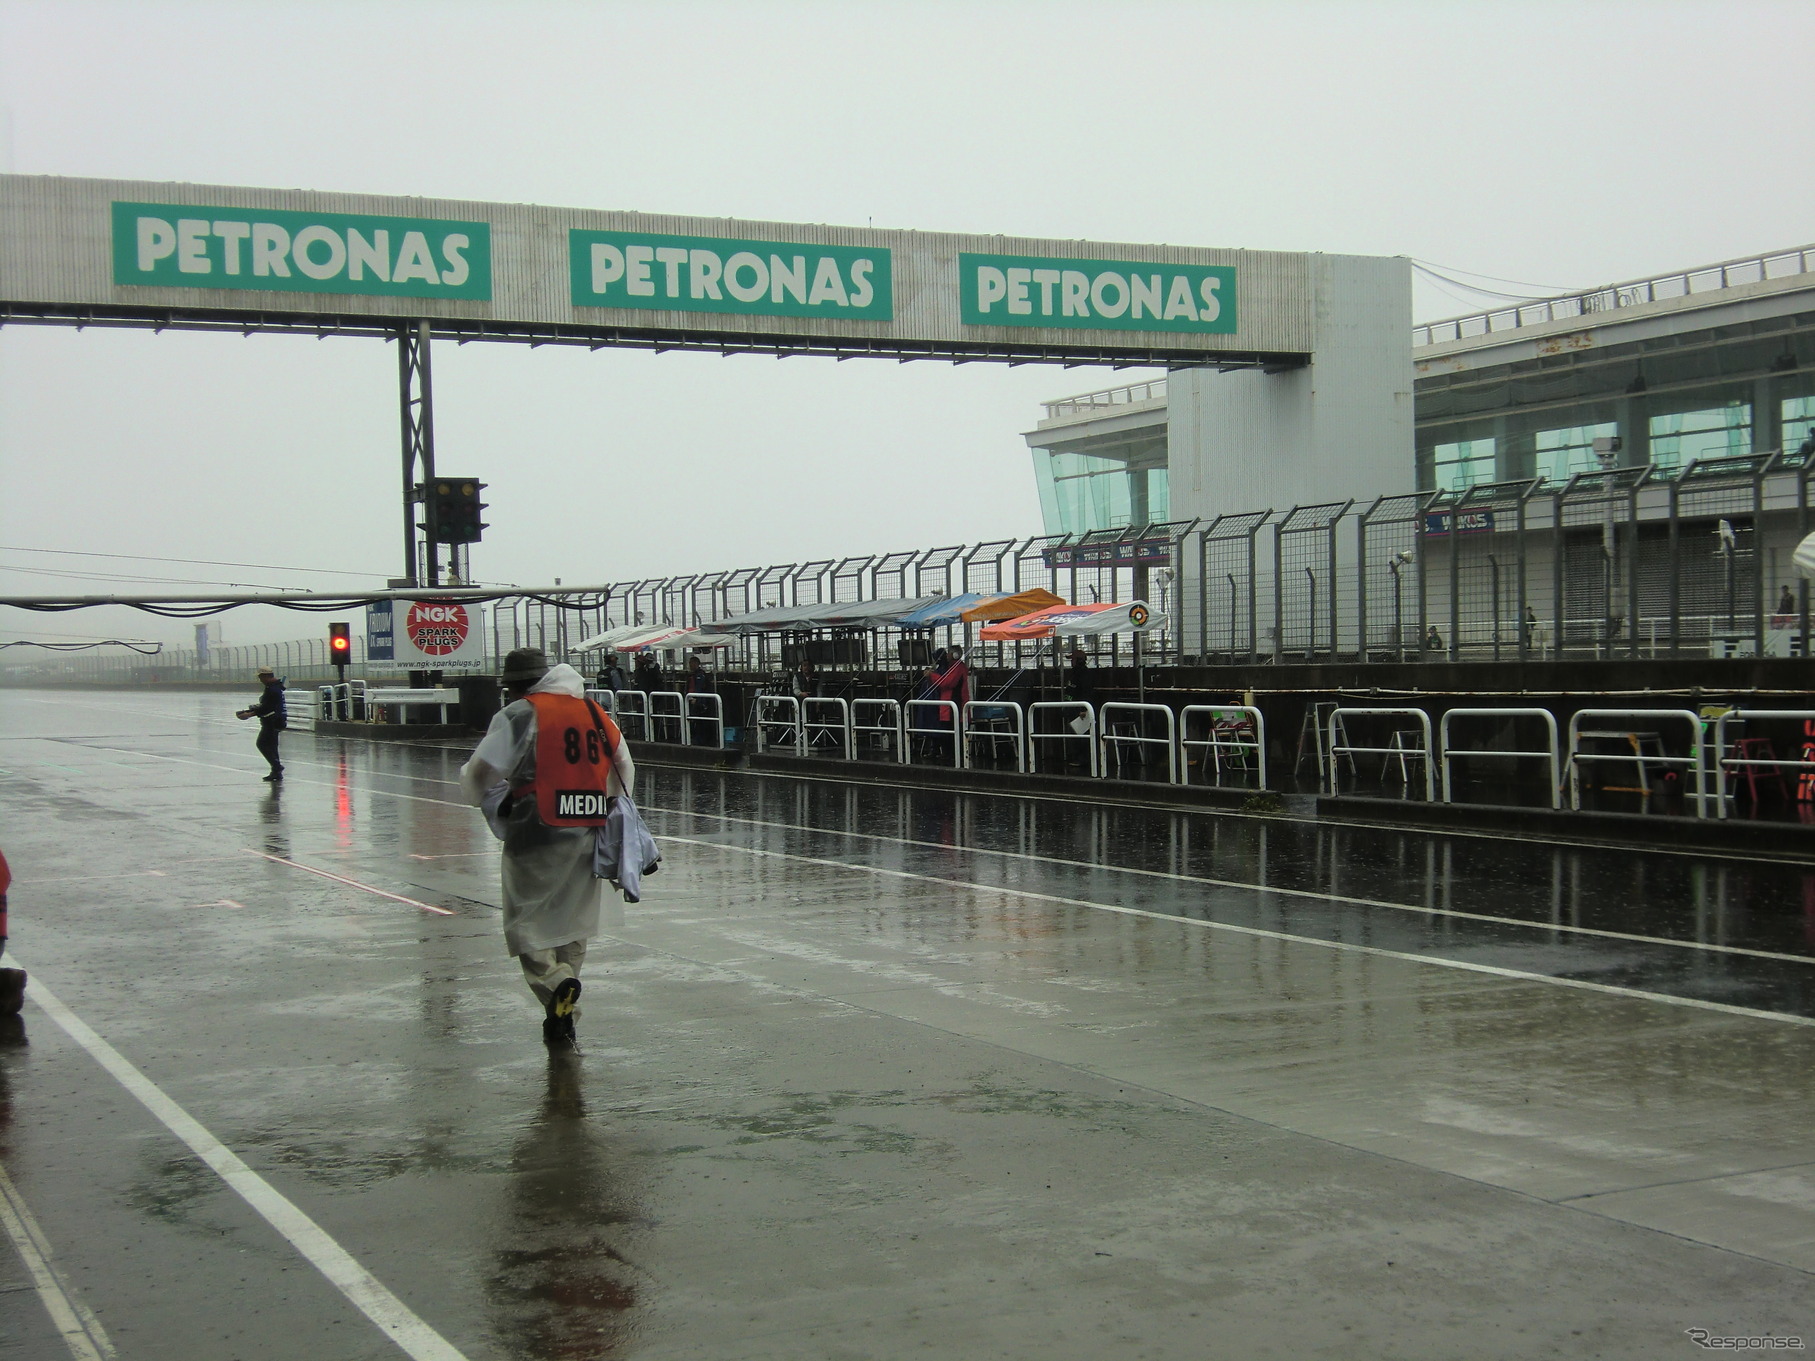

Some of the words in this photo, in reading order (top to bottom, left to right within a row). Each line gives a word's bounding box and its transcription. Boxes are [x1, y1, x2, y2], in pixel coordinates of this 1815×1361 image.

[136, 216, 470, 287] PETRONAS
[590, 243, 873, 307] PETRONAS
[977, 266, 1221, 322] PETRONAS
[415, 606, 459, 623] NGK
[418, 628, 459, 637] SPARK
[418, 637, 459, 646] PLUGS
[397, 659, 481, 668] www.ngk-sparkplugs.jp
[565, 727, 600, 764] 86
